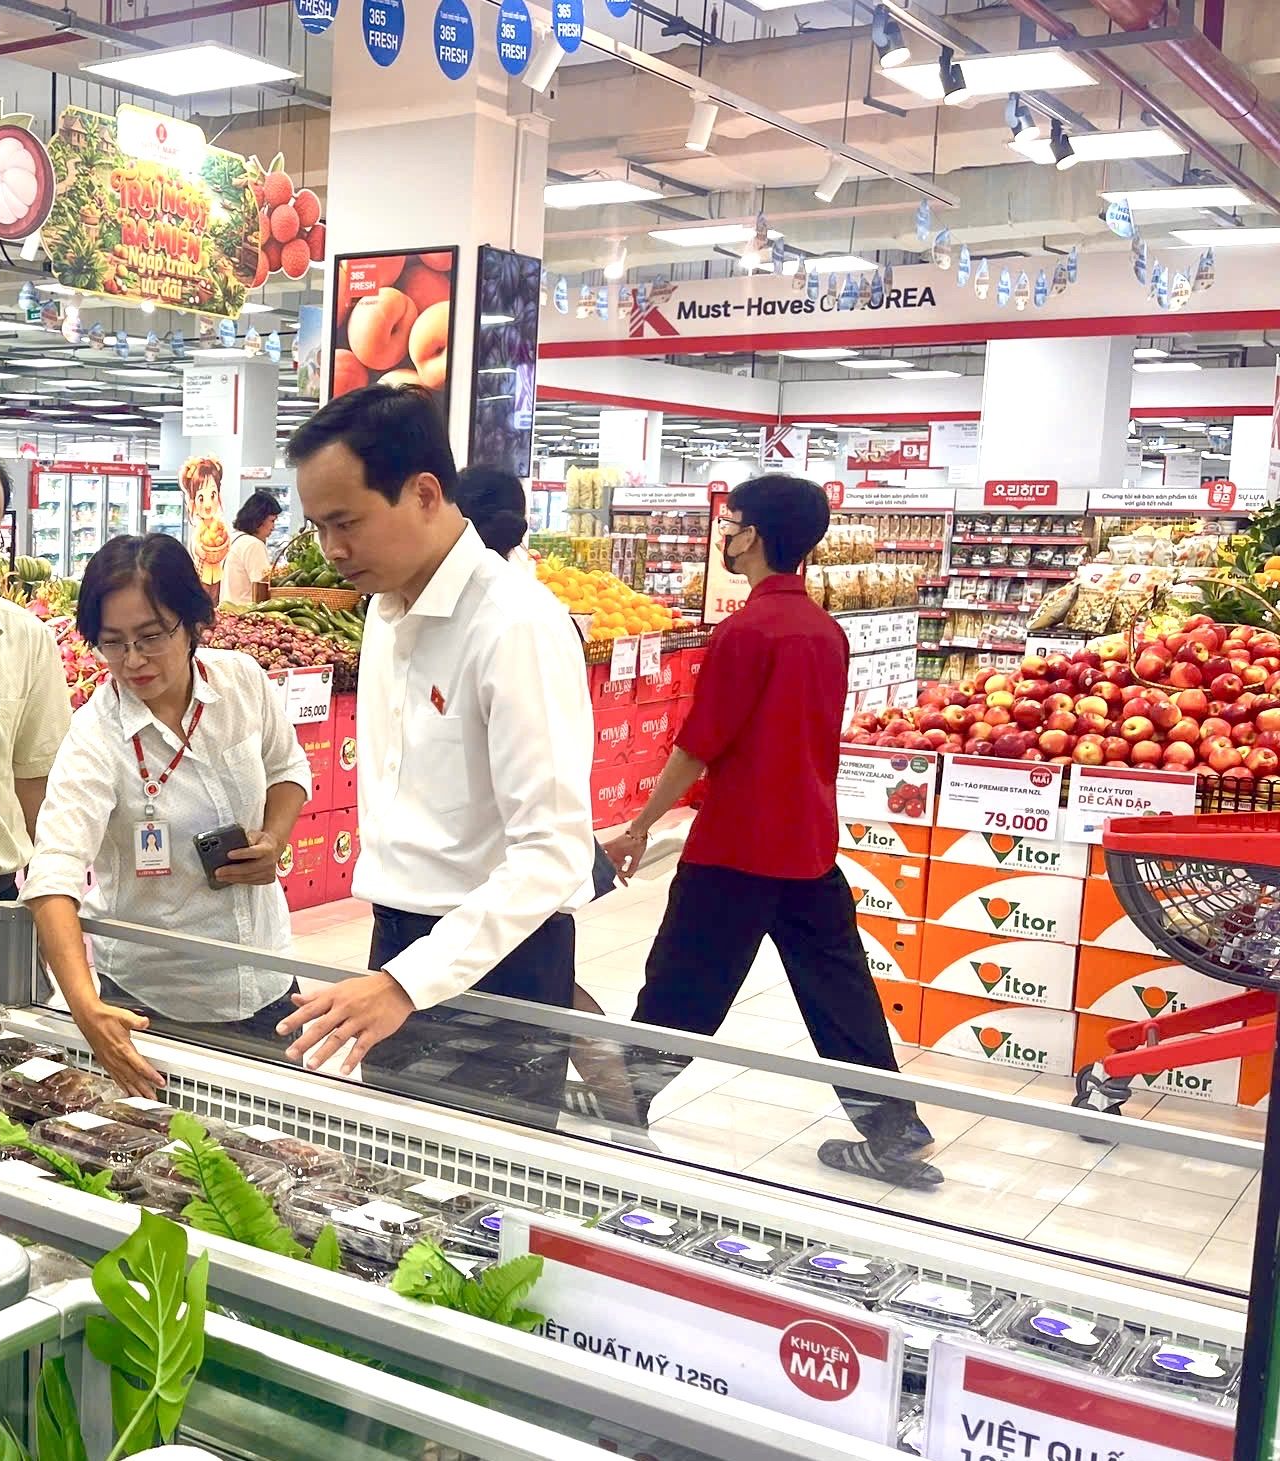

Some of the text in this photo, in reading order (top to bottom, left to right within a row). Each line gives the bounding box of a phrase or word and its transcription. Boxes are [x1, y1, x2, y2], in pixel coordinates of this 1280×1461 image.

[300, 0, 332, 17] FRESH
[369, 8, 386, 26] 365
[557, 3, 572, 18] 365
[439, 24, 456, 41] 365
[501, 22, 515, 39] 365
[558, 23, 581, 38] FRESH
[369, 31, 399, 50] FRESH
[439, 45, 468, 65] FRESH
[501, 42, 527, 60] FRESH
[349, 271, 366, 281] 365
[349, 281, 377, 291] FRESH
[676, 296, 816, 321] Must-Haves
[298, 704, 328, 718] 125,000
[848, 761, 876, 770] PREMIER
[865, 771, 895, 780] ZEALAND
[978, 783, 1009, 793] PREMIER
[1008, 786, 1028, 795] STAR
[1027, 788, 1043, 796] NZL
[1078, 784, 1134, 796] TRÁI CÂY TƯƠI
[1124, 796, 1153, 812] DẬP
[983, 811, 1049, 833] 79,000
[789, 1334, 850, 1365] KHUYẾN
[572, 1329, 729, 1397] QUẤT MỸ 125G
[788, 1352, 849, 1391] MÃI
[960, 1413, 1041, 1459] VIỆT
